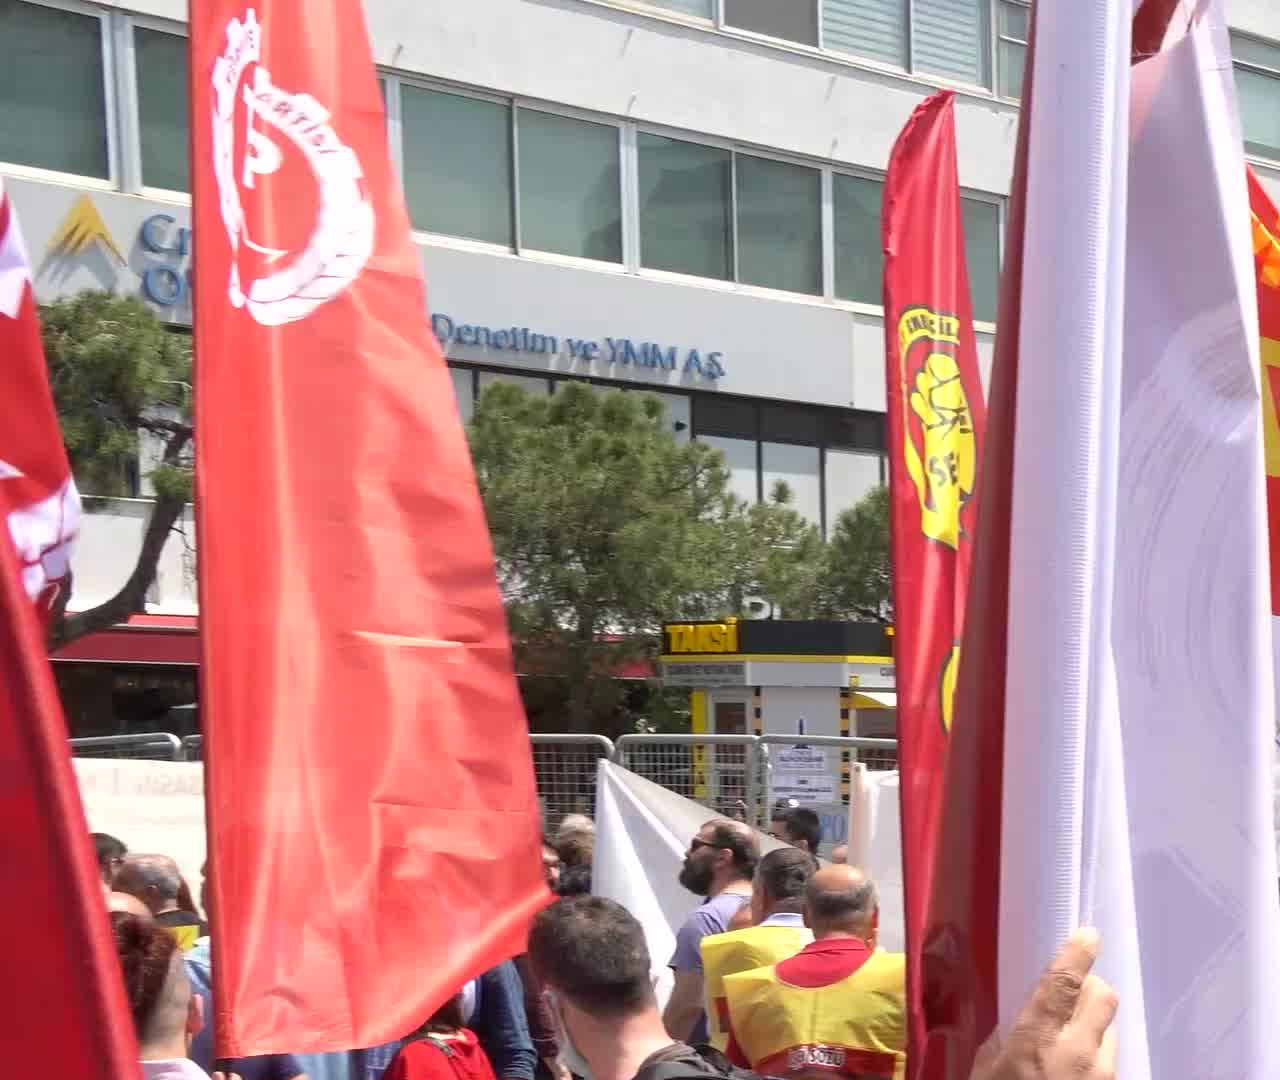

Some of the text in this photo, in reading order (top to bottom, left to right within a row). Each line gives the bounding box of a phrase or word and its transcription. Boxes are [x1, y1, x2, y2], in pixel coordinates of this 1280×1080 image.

[432, 312, 557, 354] Denetim
[566, 336, 598, 361] ve
[606, 336, 678, 370] YMM
